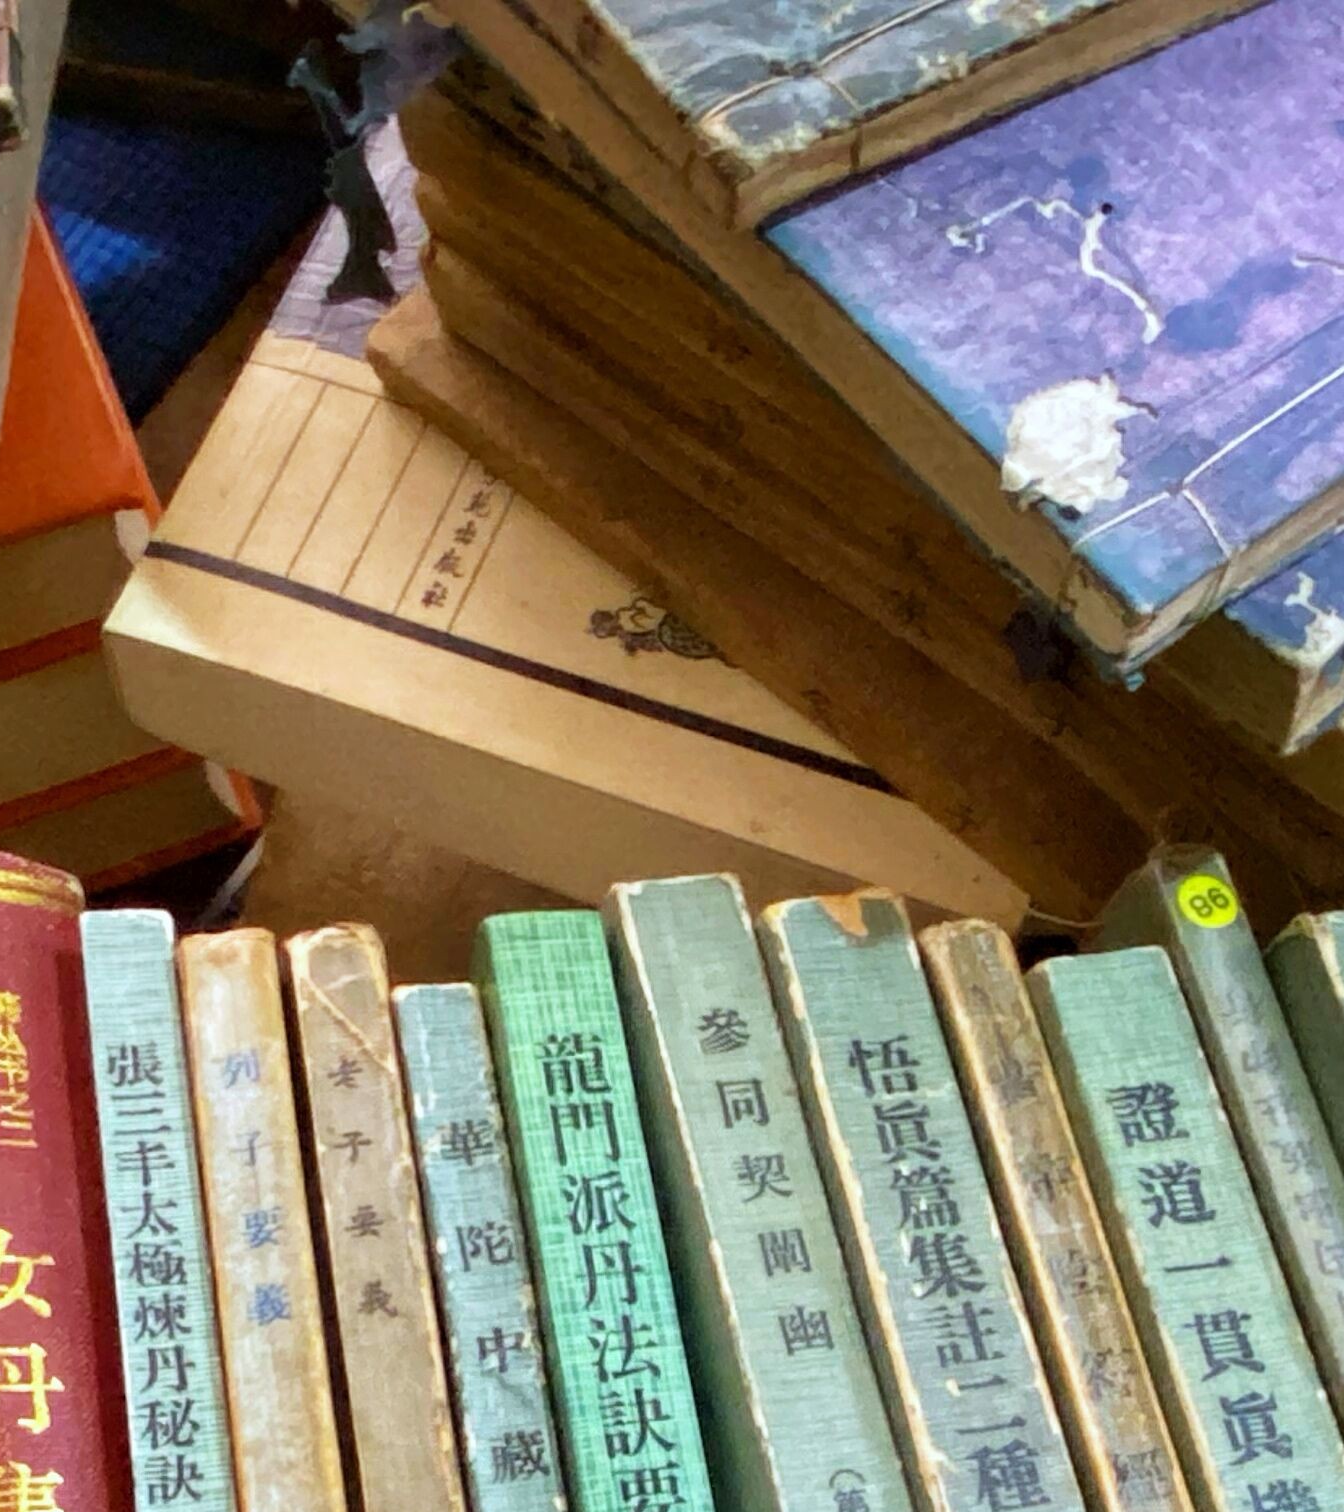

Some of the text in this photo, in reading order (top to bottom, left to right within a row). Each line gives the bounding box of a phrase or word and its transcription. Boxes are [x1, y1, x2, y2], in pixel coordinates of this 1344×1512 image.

[219, 1047, 292, 1326] 列子要義
[326, 1054, 400, 1319] 老子要義
[697, 1005, 835, 1359] 參同契闡幽
